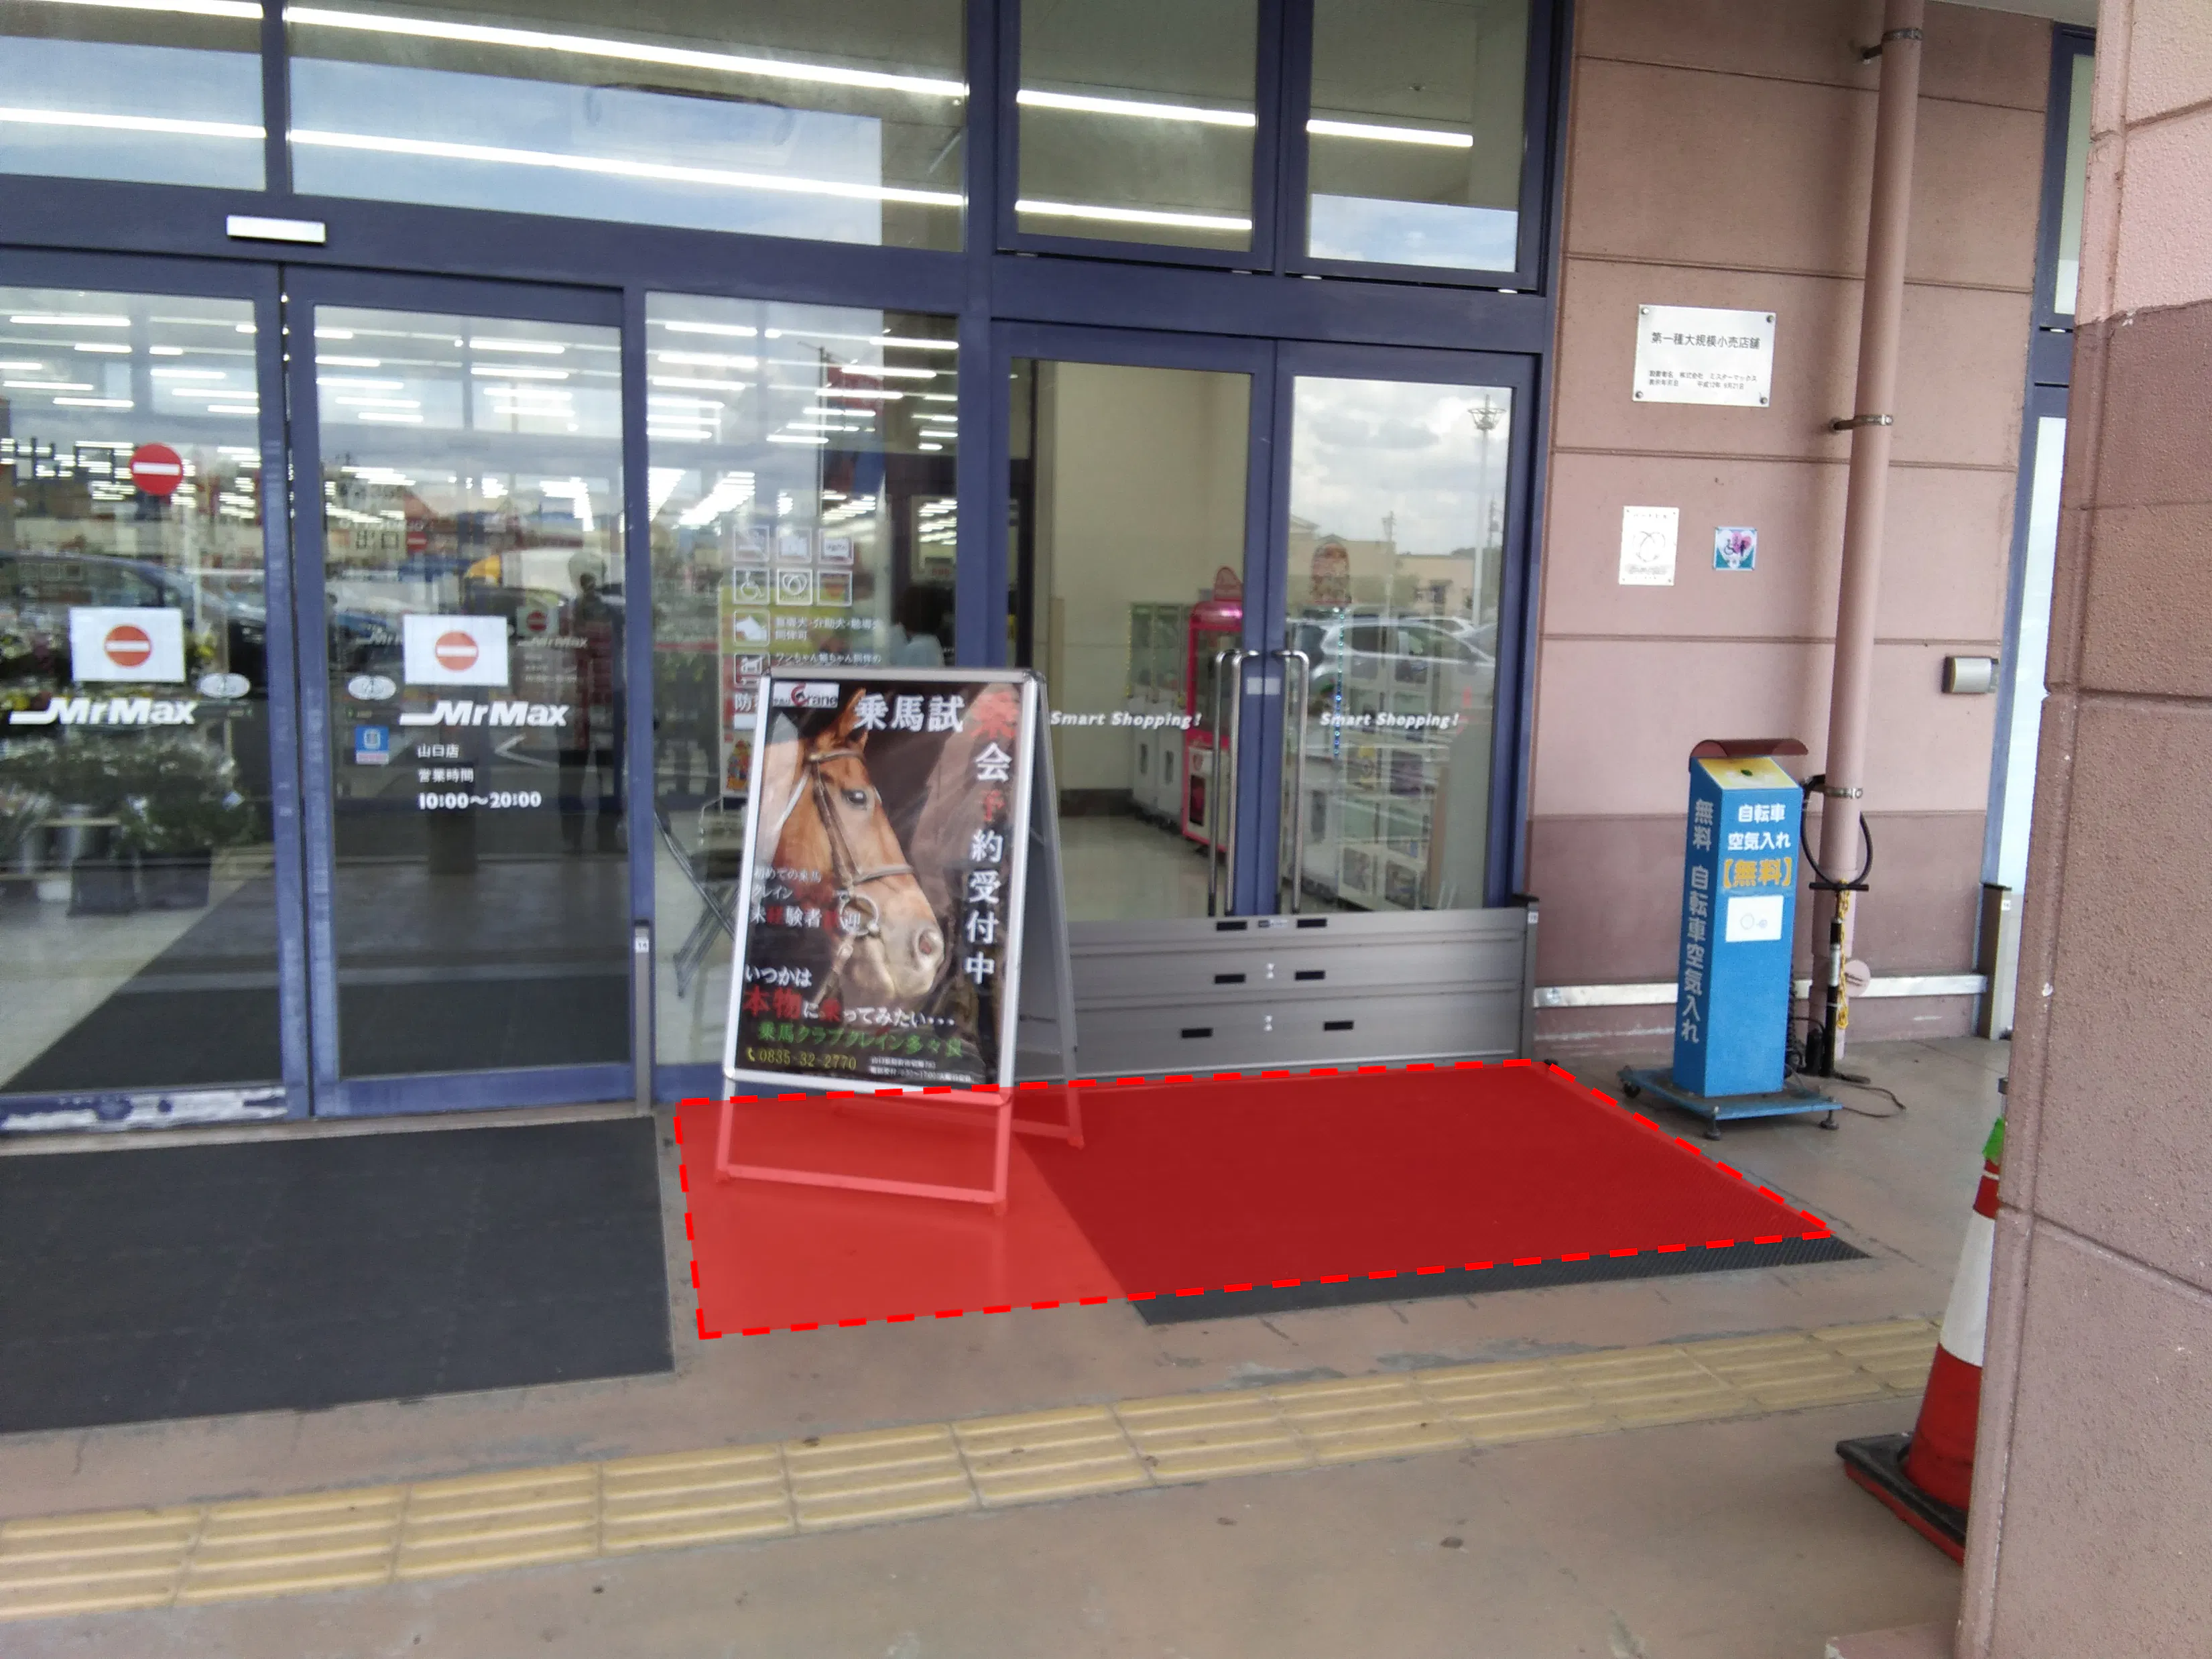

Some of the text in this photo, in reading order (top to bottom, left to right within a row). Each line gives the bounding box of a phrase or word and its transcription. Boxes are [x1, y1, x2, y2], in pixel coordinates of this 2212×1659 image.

[1651, 332, 1761, 350] 第一種大規模小売店舗
[9, 697, 198, 725] MrMax
[399, 700, 569, 727] MrMax
[1050, 711, 1202, 729] Smart Shopping!
[1320, 712, 1459, 729] Smart Shopping!
[418, 744, 459, 759] 山口店
[418, 769, 474, 784] 営業時間
[1738, 803, 1786, 823] 自転車
[1727, 832, 1792, 851] 空気入れ
[1681, 798, 1714, 1044] 無料 自転車空気入れ
[745, 964, 812, 988] いつかは
